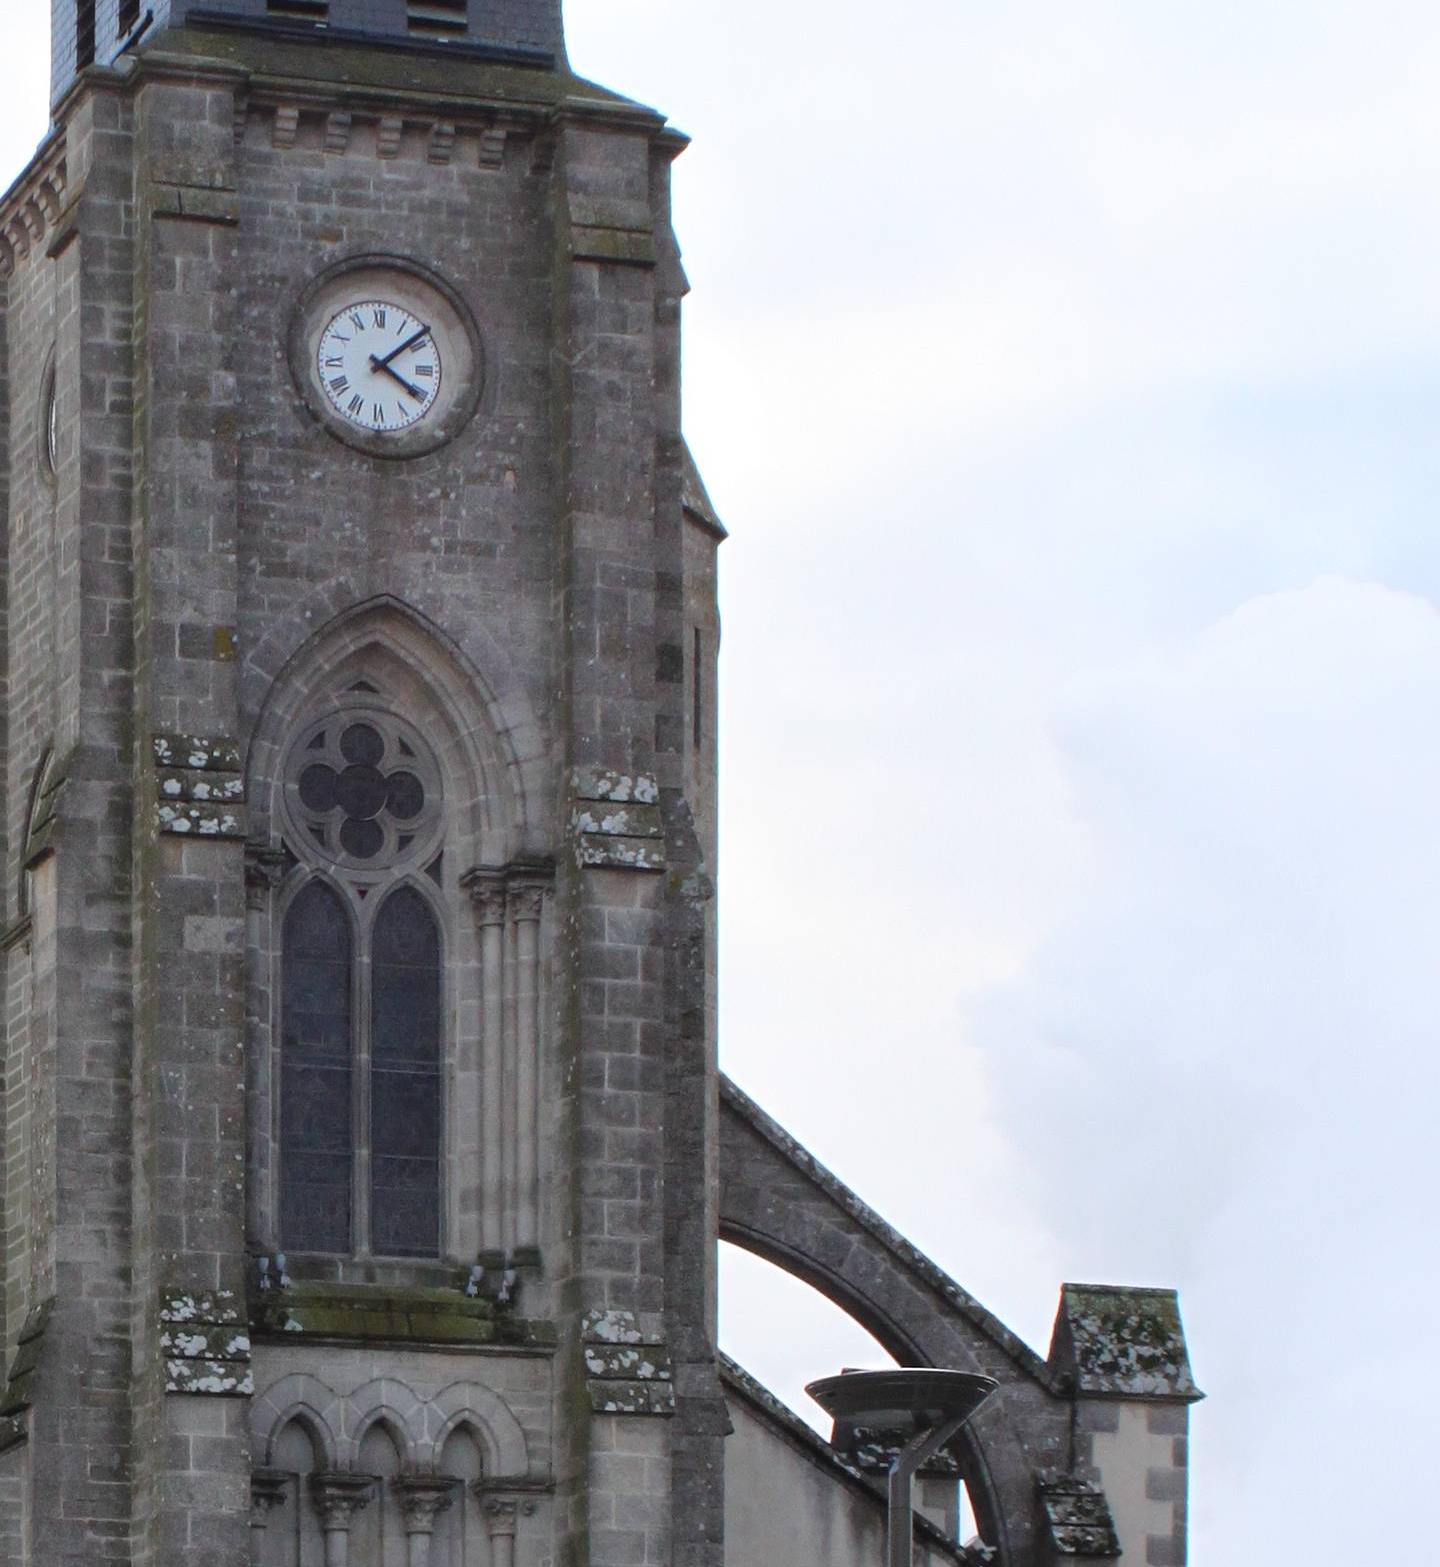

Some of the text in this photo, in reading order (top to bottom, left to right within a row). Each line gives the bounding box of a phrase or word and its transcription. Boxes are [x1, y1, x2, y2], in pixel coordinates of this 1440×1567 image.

[349, 312, 365, 335] XI
[372, 310, 386, 329] XII
[415, 365, 433, 377] III
